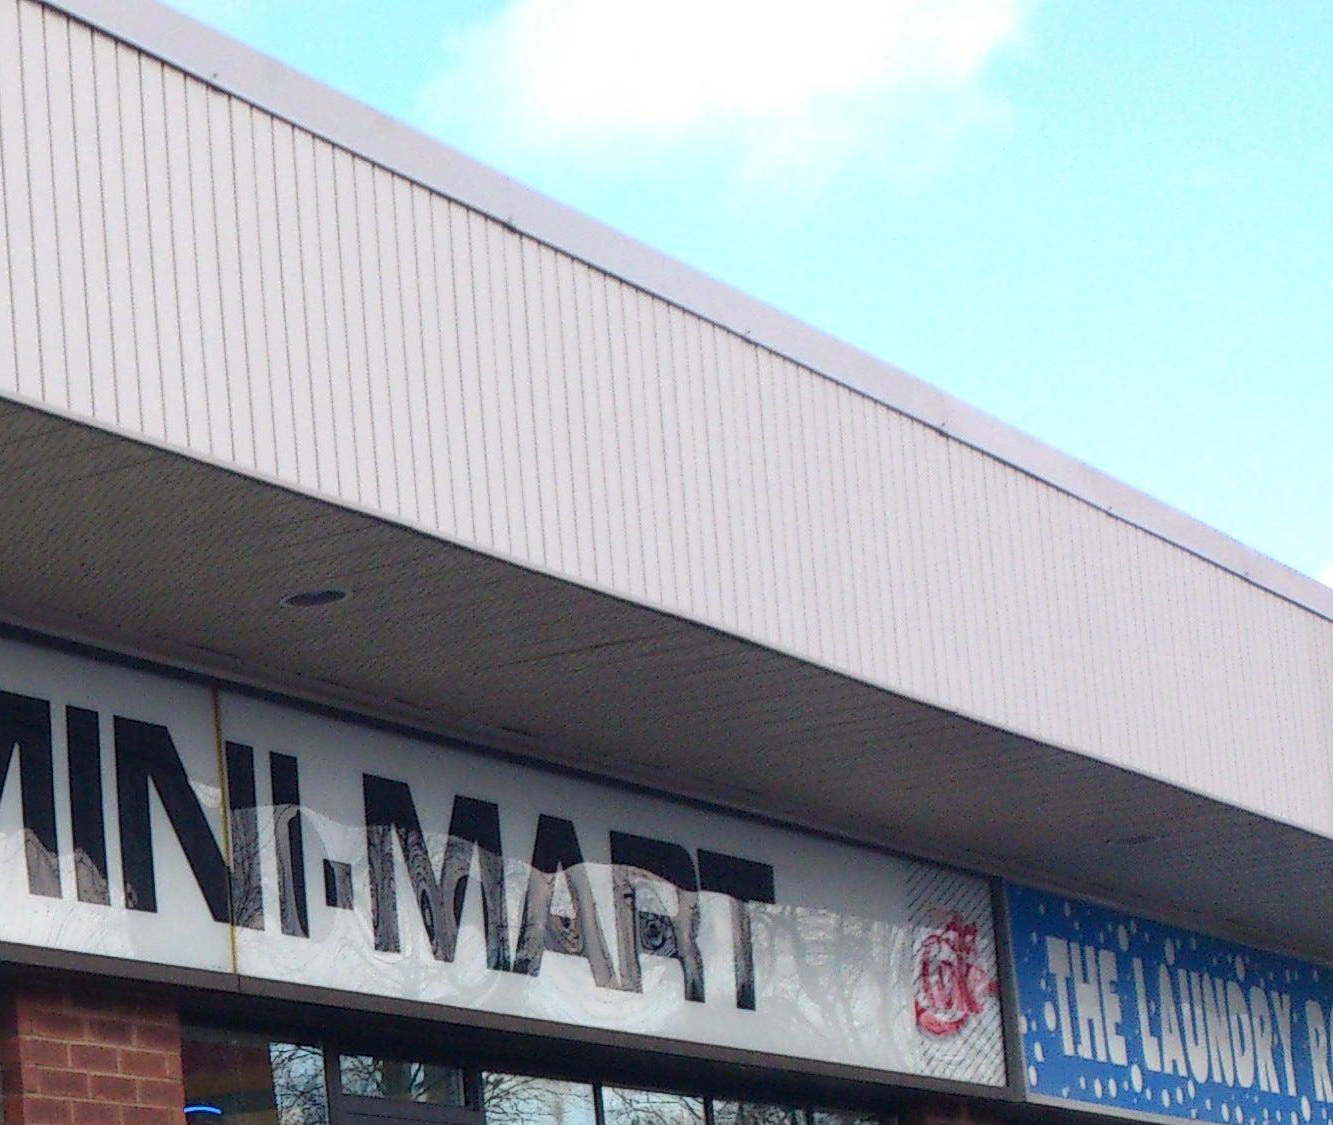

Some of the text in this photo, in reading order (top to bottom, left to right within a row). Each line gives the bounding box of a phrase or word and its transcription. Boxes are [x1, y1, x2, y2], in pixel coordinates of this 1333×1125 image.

[1046, 935, 1128, 1067] THE
[1133, 957, 1297, 1097] LAUNDRY
[1304, 999, 1333, 1104] R
